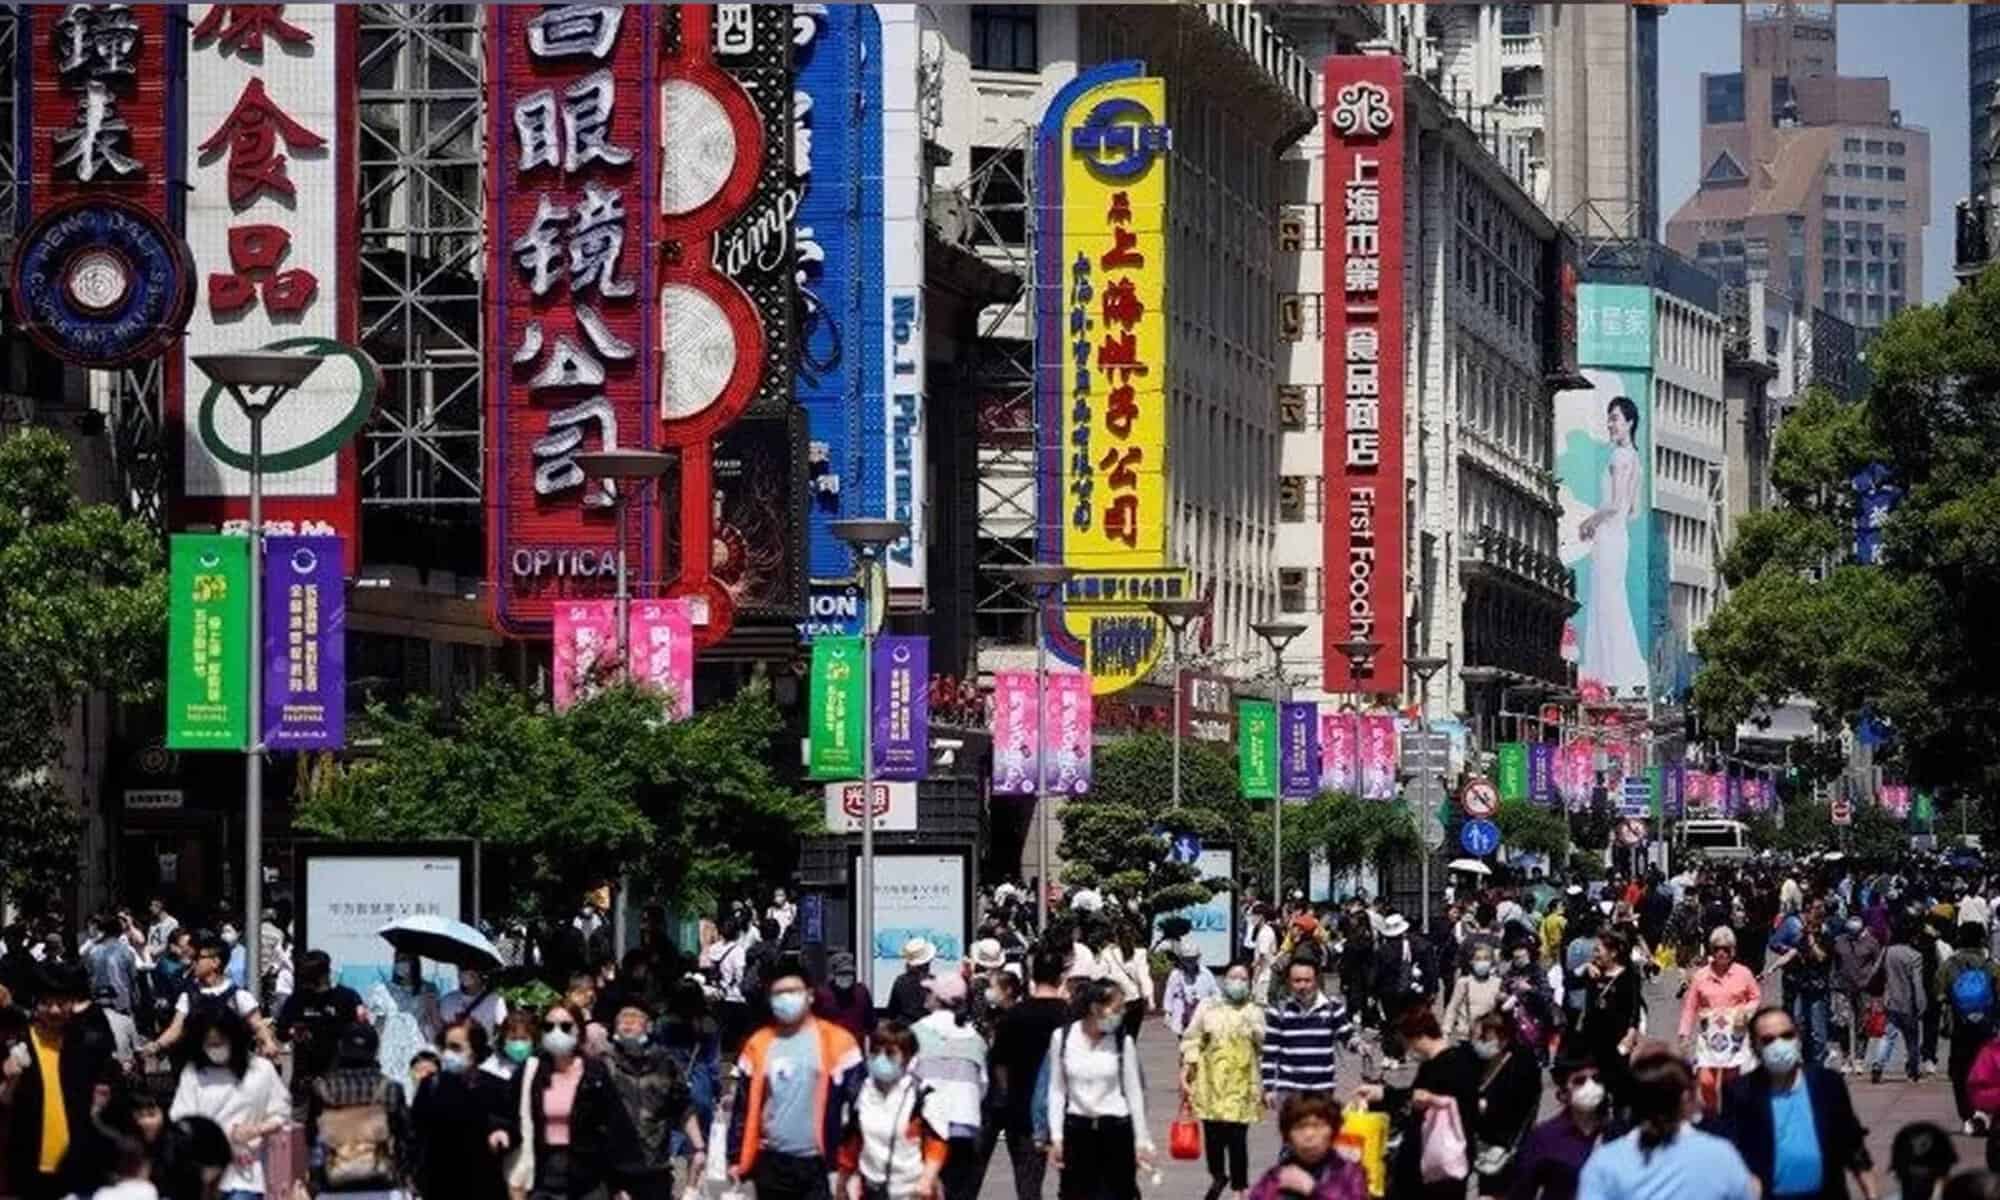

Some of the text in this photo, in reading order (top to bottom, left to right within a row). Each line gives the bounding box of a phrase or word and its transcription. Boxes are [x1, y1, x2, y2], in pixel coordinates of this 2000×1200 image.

[1344, 153, 1380, 466] 上海市第一食品商店
[1349, 486, 1375, 539] First
[512, 549, 635, 577] OPTICA
